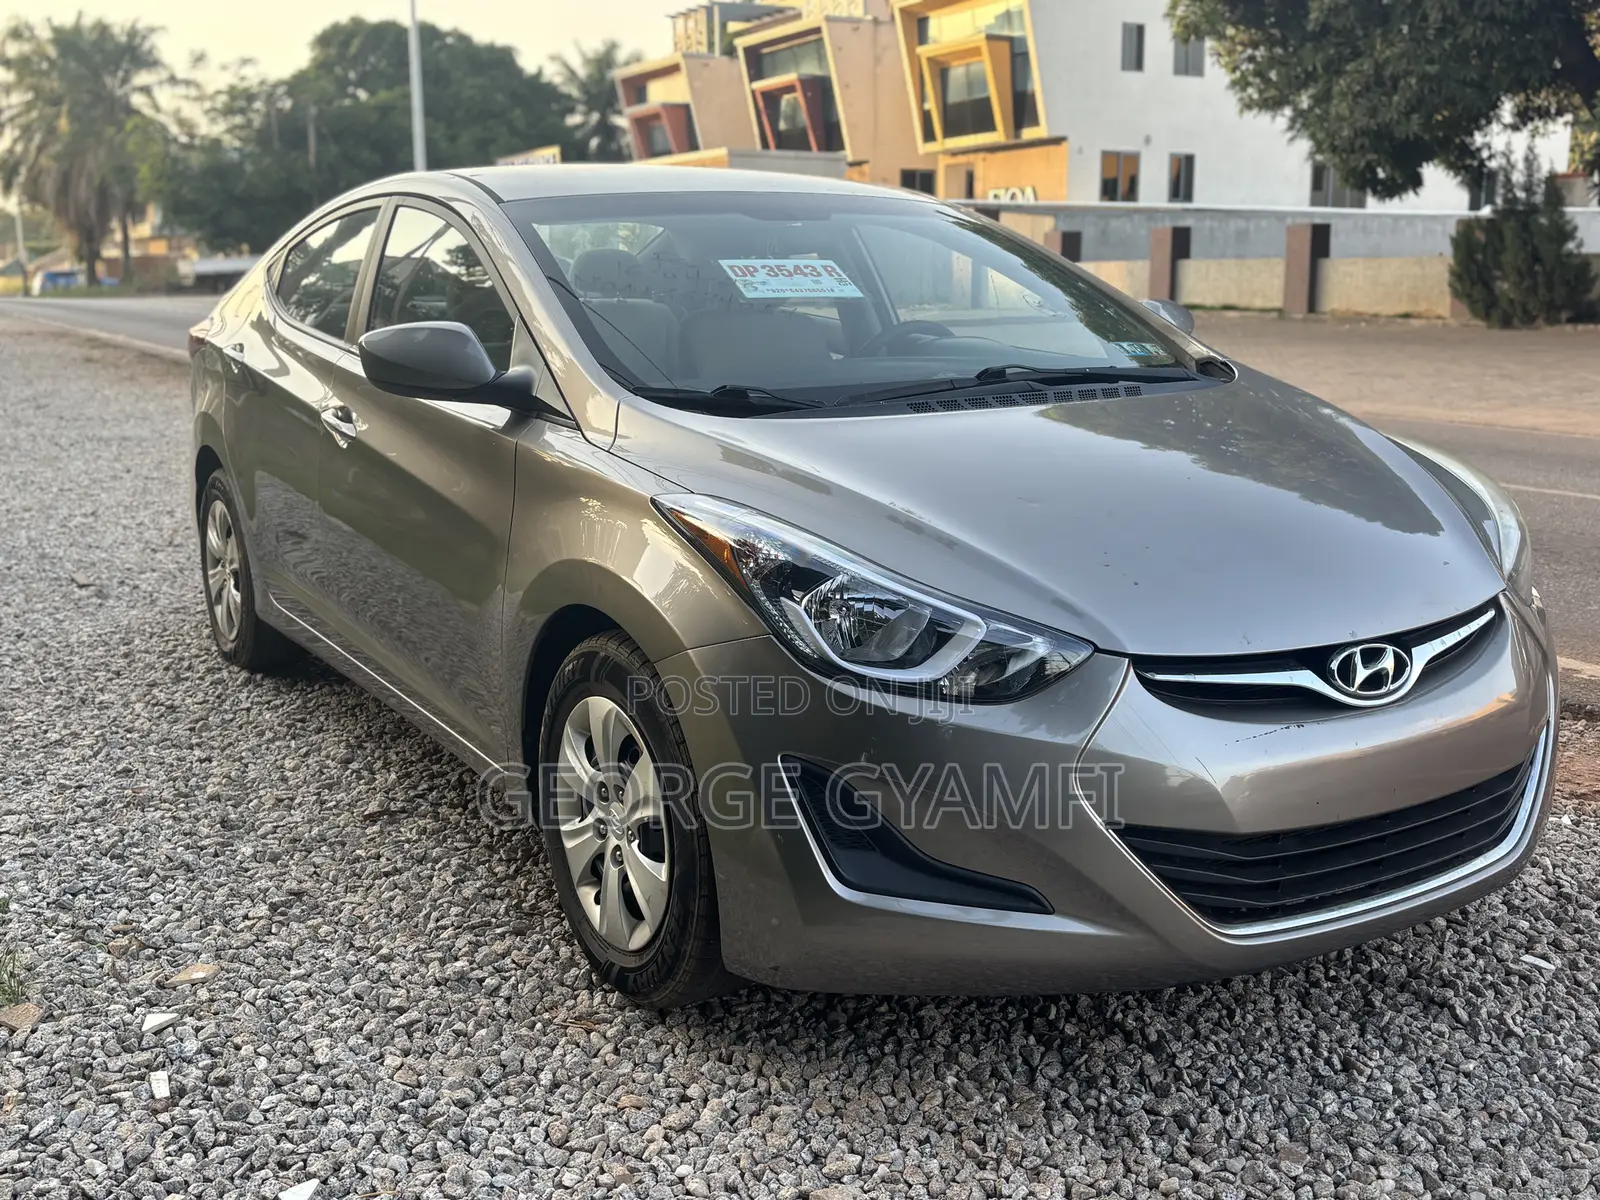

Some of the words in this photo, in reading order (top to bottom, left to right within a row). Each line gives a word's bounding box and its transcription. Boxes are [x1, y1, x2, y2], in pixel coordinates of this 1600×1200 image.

[726, 264, 759, 278] DP
[760, 264, 823, 278] 3543
[821, 264, 844, 278] R
